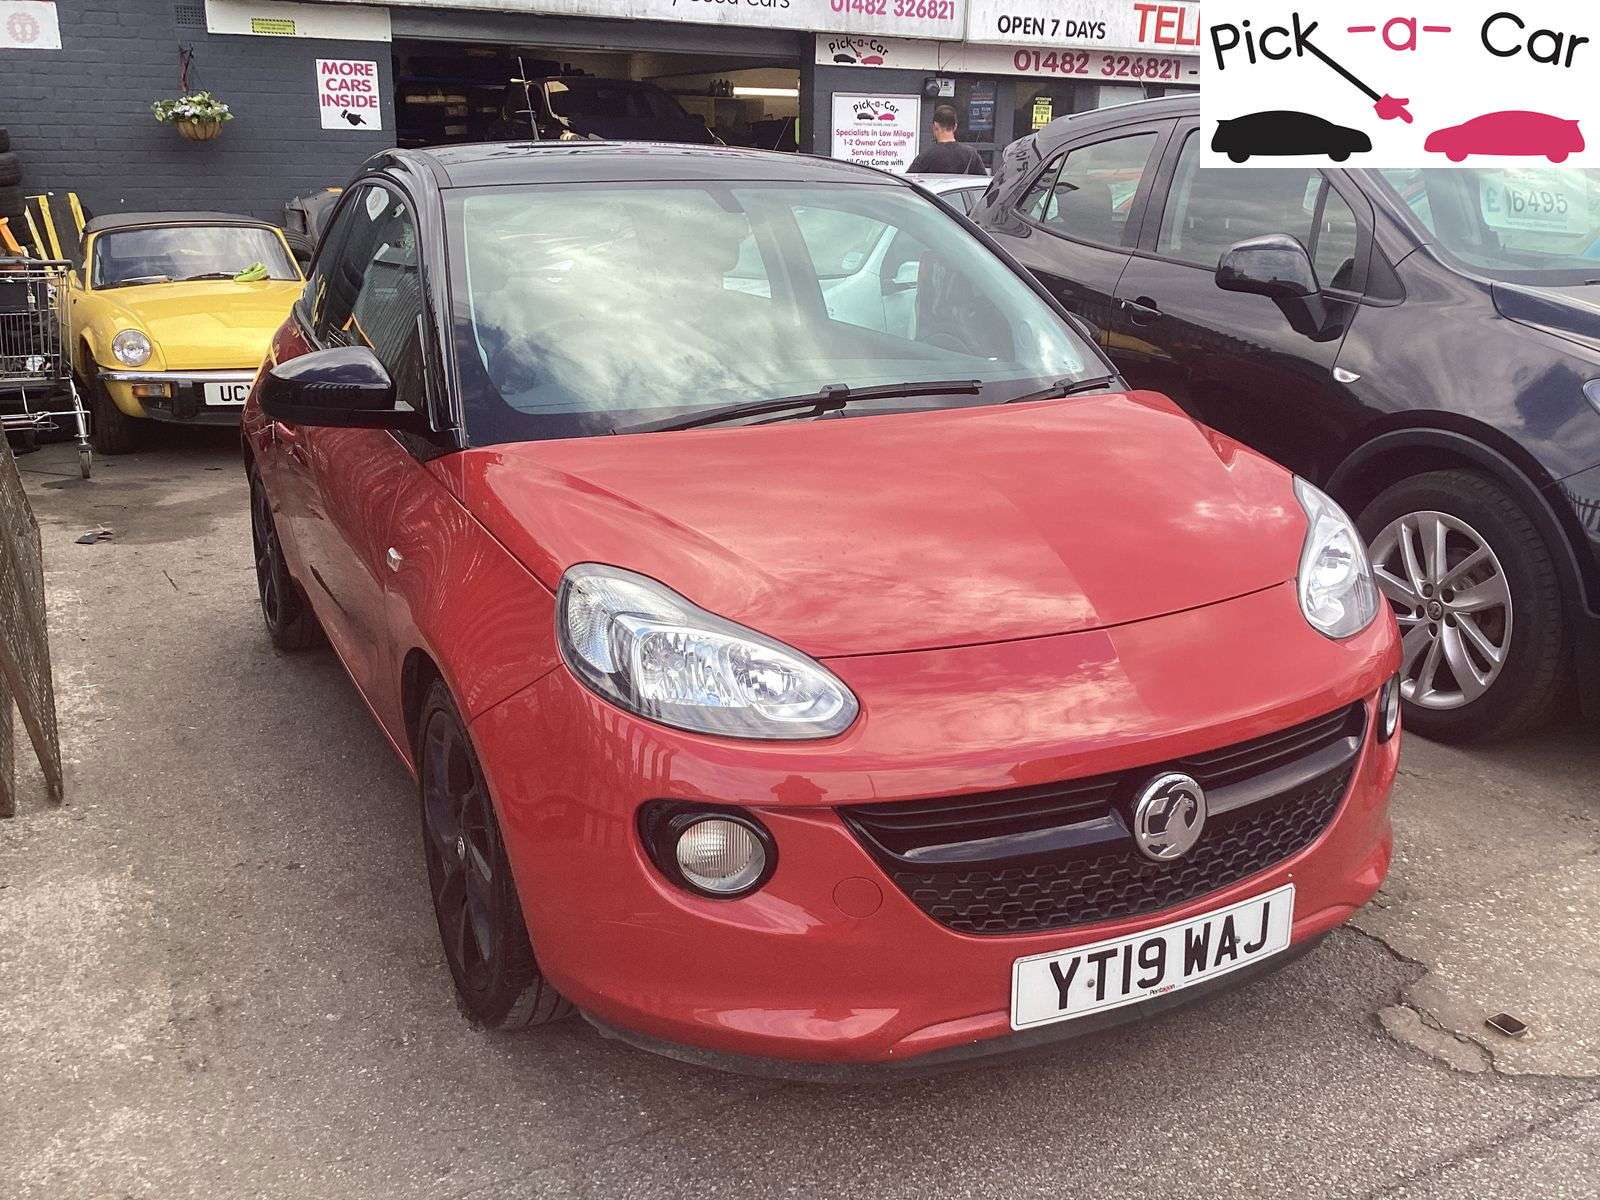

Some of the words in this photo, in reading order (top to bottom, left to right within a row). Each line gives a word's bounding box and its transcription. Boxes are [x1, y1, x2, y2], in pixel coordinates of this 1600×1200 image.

[831, 0, 887, 15] 01482
[893, 0, 955, 20] 326821
[998, 15, 1045, 35] OPEN
[1051, 19, 1060, 37] 7
[1065, 20, 1106, 40] DAYS
[1134, 3, 1200, 46] TEL
[321, 62, 374, 76] MORE
[1013, 50, 1090, 74] 01482
[1101, 55, 1181, 79] 326821
[325, 78, 372, 92] CARS
[321, 94, 378, 108] INSIDE
[836, 129, 869, 138] Specialists
[879, 129, 892, 137] Low
[855, 139, 876, 147] Owner
[851, 149, 874, 157] Service
[871, 158, 889, 166] Come
[891, 158, 904, 166] with
[220, 385, 250, 401] UC
[1049, 936, 1167, 1010] YT19
[1183, 901, 1270, 977] WAJ
